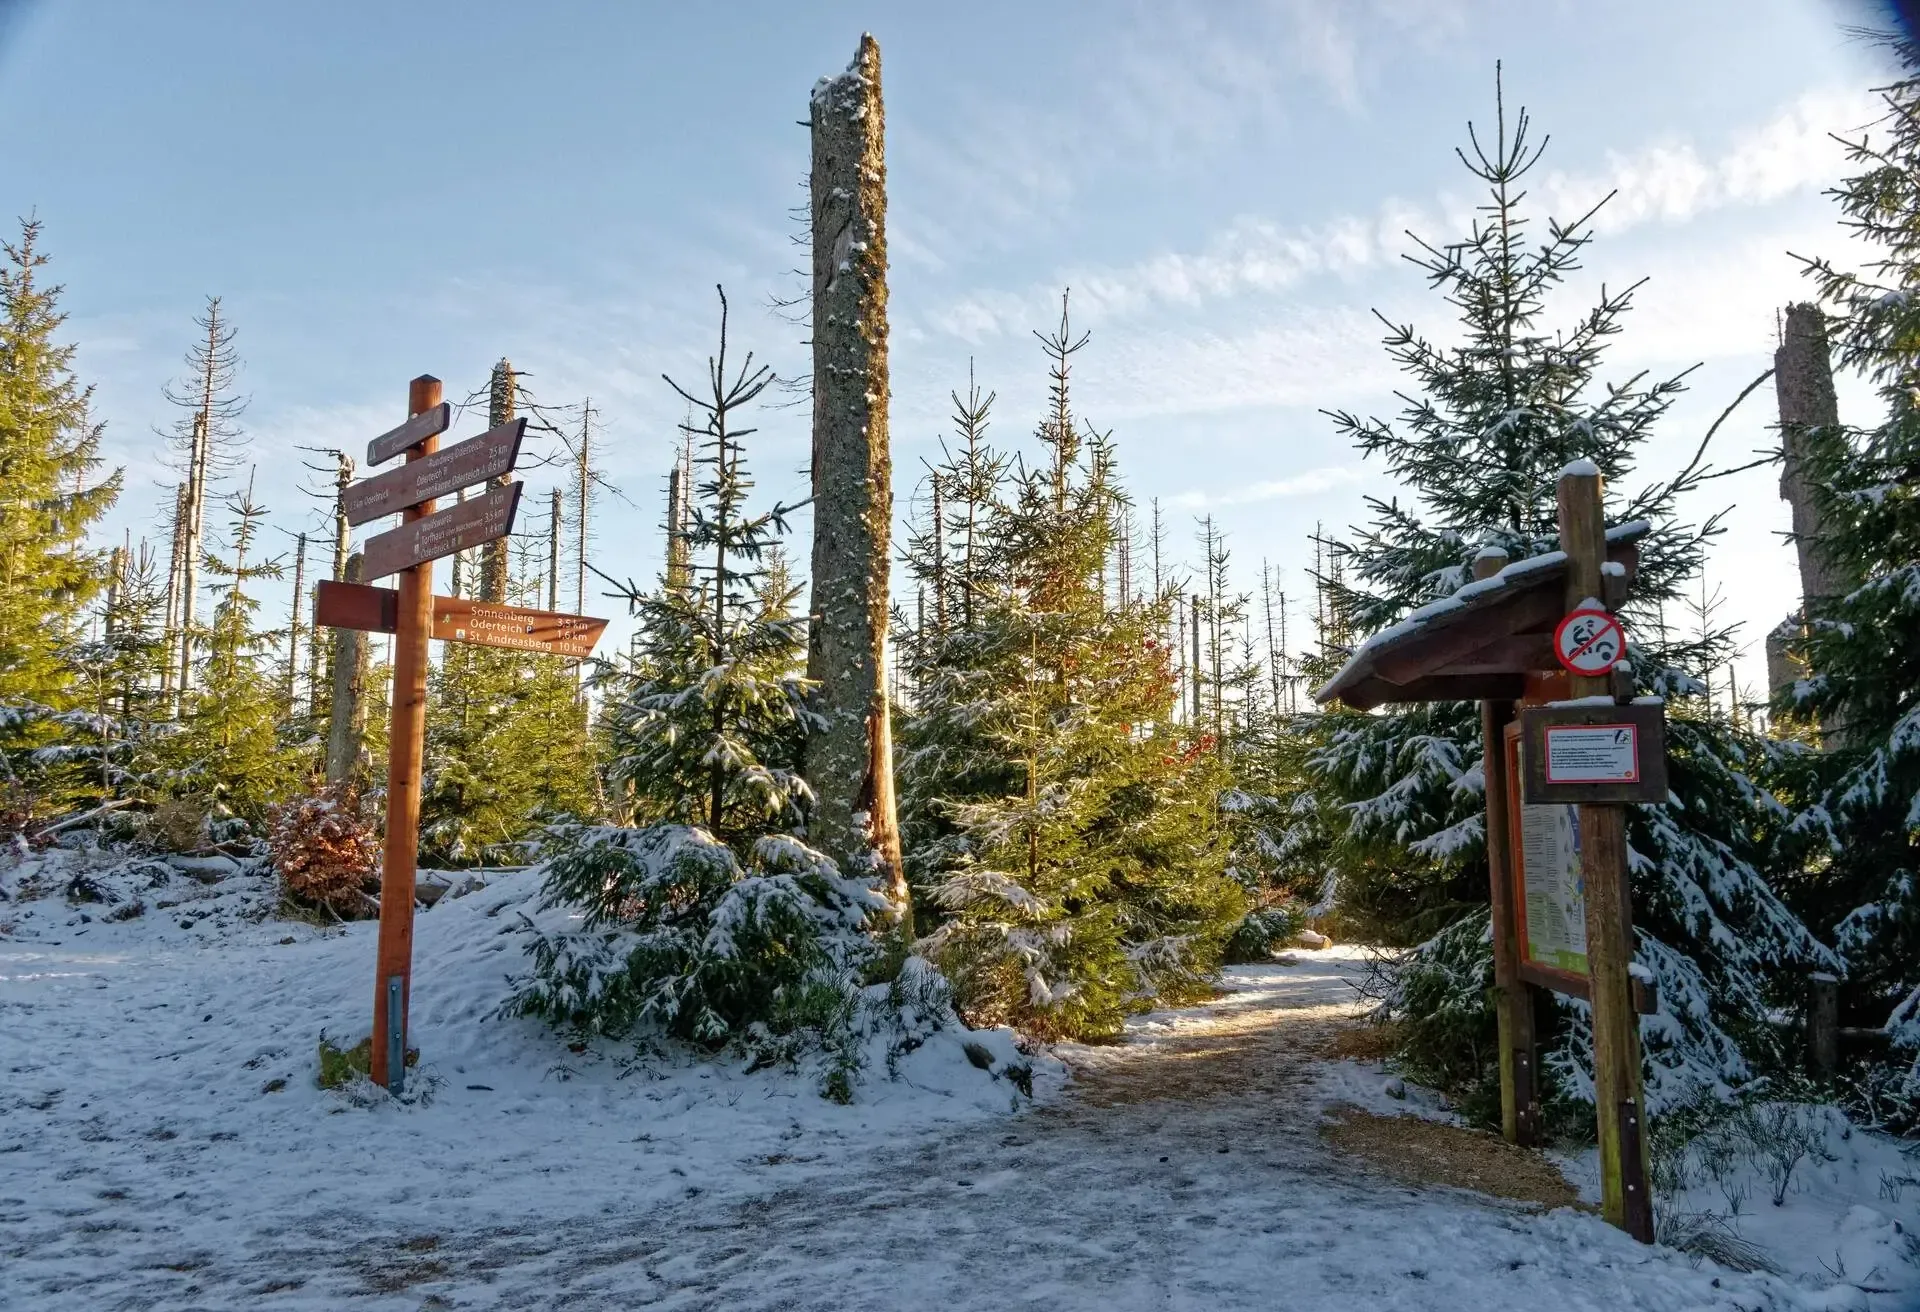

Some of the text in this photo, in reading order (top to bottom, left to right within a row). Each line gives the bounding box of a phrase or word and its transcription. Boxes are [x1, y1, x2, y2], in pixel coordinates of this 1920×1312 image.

[416, 469, 442, 486] Oderteich
[498, 445, 508, 456] km
[452, 469, 480, 486] Oderteich
[497, 460, 507, 471] km
[494, 494, 504, 505] km
[494, 508, 504, 519] km
[494, 523, 504, 534] km
[471, 606, 534, 625] Sonnenberg
[573, 618, 588, 630] km
[470, 618, 522, 634] Oderteich
[572, 631, 588, 641] km
[469, 632, 587, 653] St. Andreasberg 10 km
